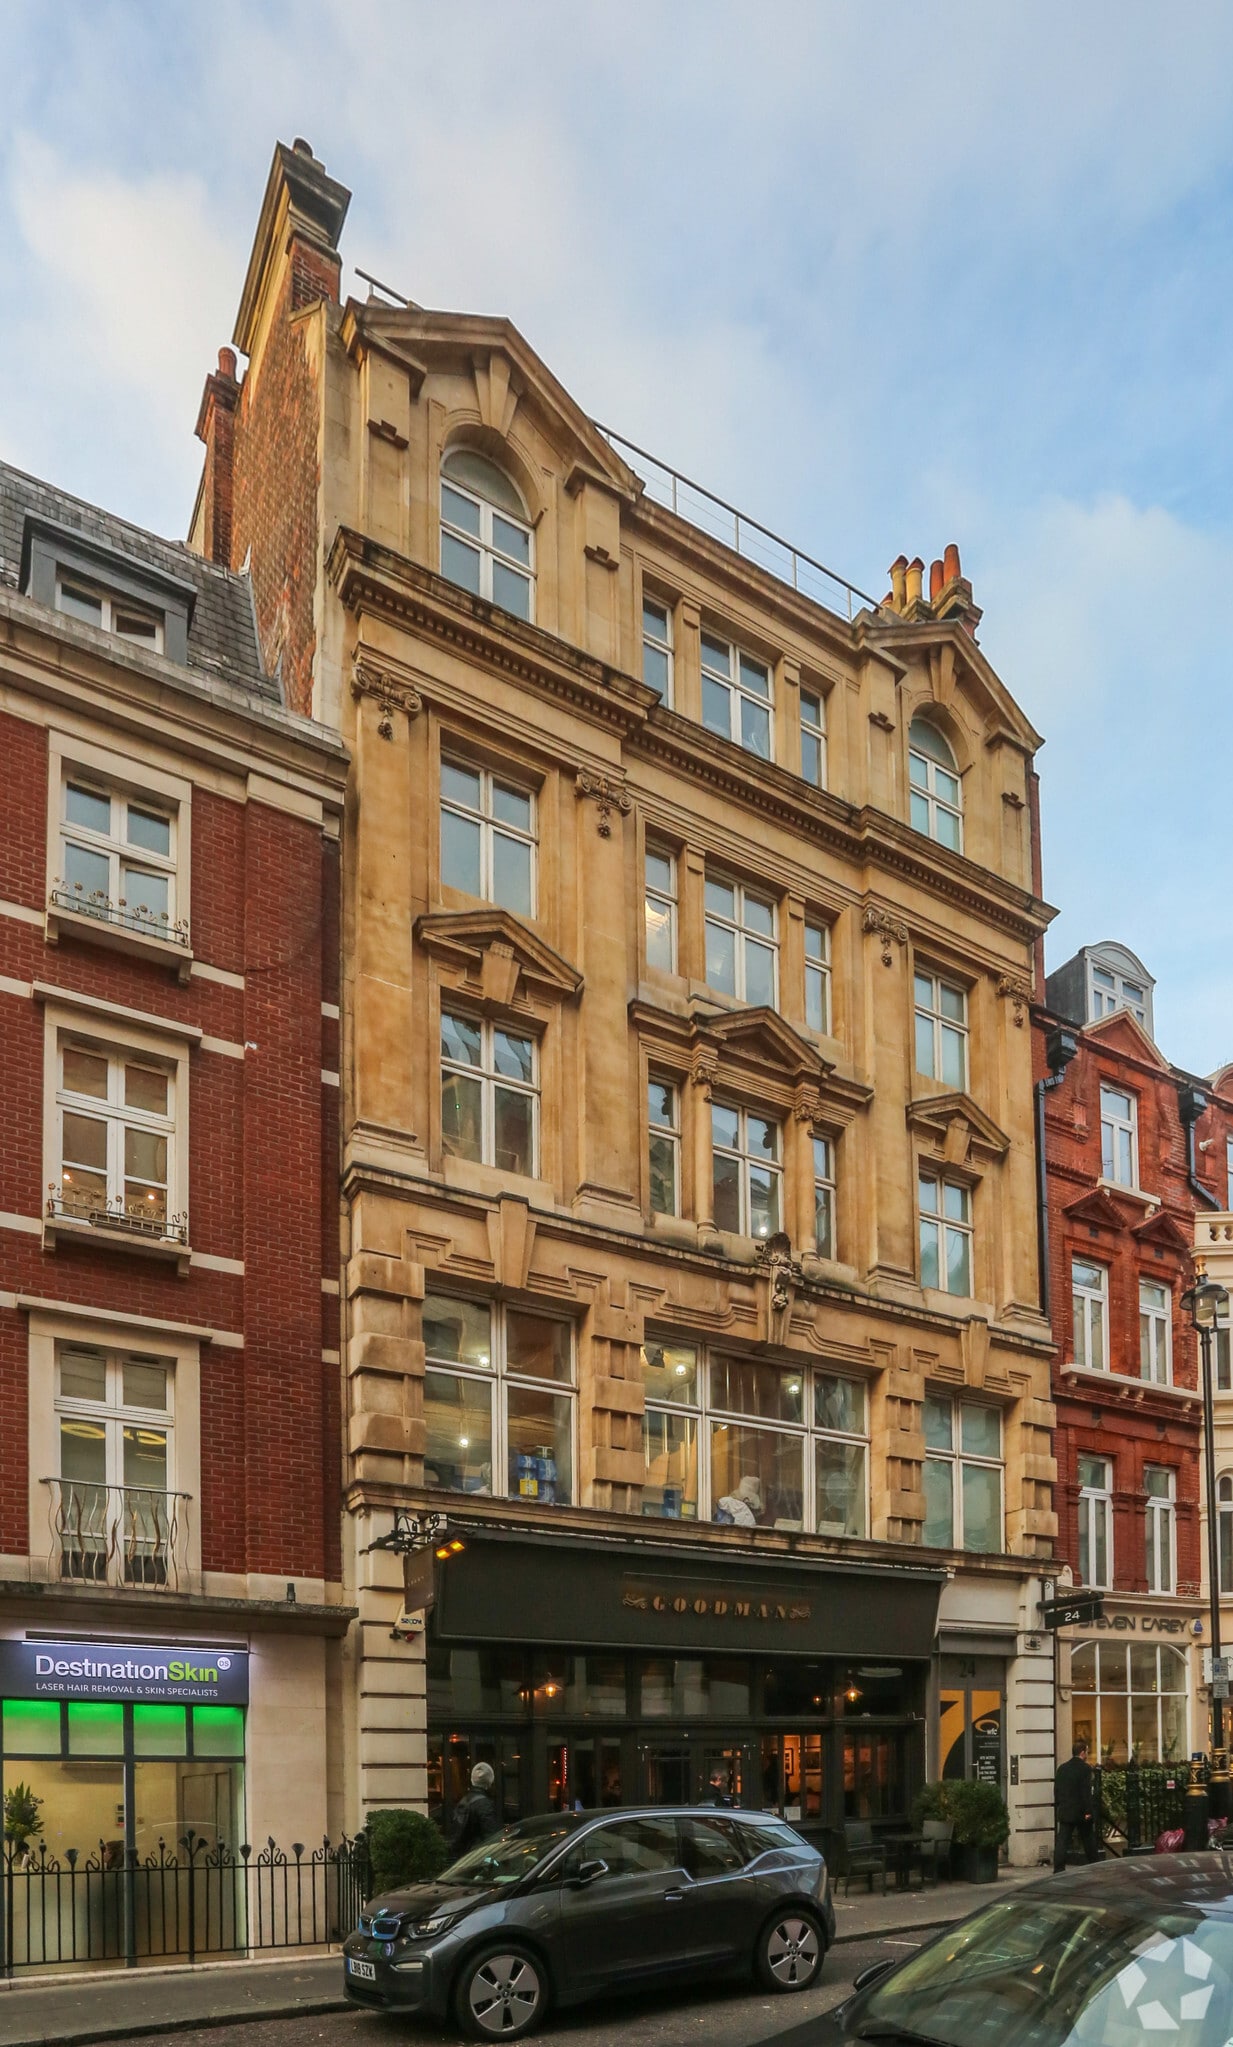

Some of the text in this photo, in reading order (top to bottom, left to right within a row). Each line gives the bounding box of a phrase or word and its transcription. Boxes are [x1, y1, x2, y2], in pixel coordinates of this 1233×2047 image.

[1064, 1611, 1080, 1622] 24
[1142, 1617, 1187, 1634] CAREY
[35, 1655, 219, 1682] DestinationSkin
[219, 1659, 230, 1667] DS
[959, 1660, 976, 1678] 24
[36, 1683, 64, 1691] LASER
[91, 1685, 135, 1694] REMOVAL
[145, 1687, 165, 1695] SKIN
[167, 1688, 218, 1697] SPECIALISTS
